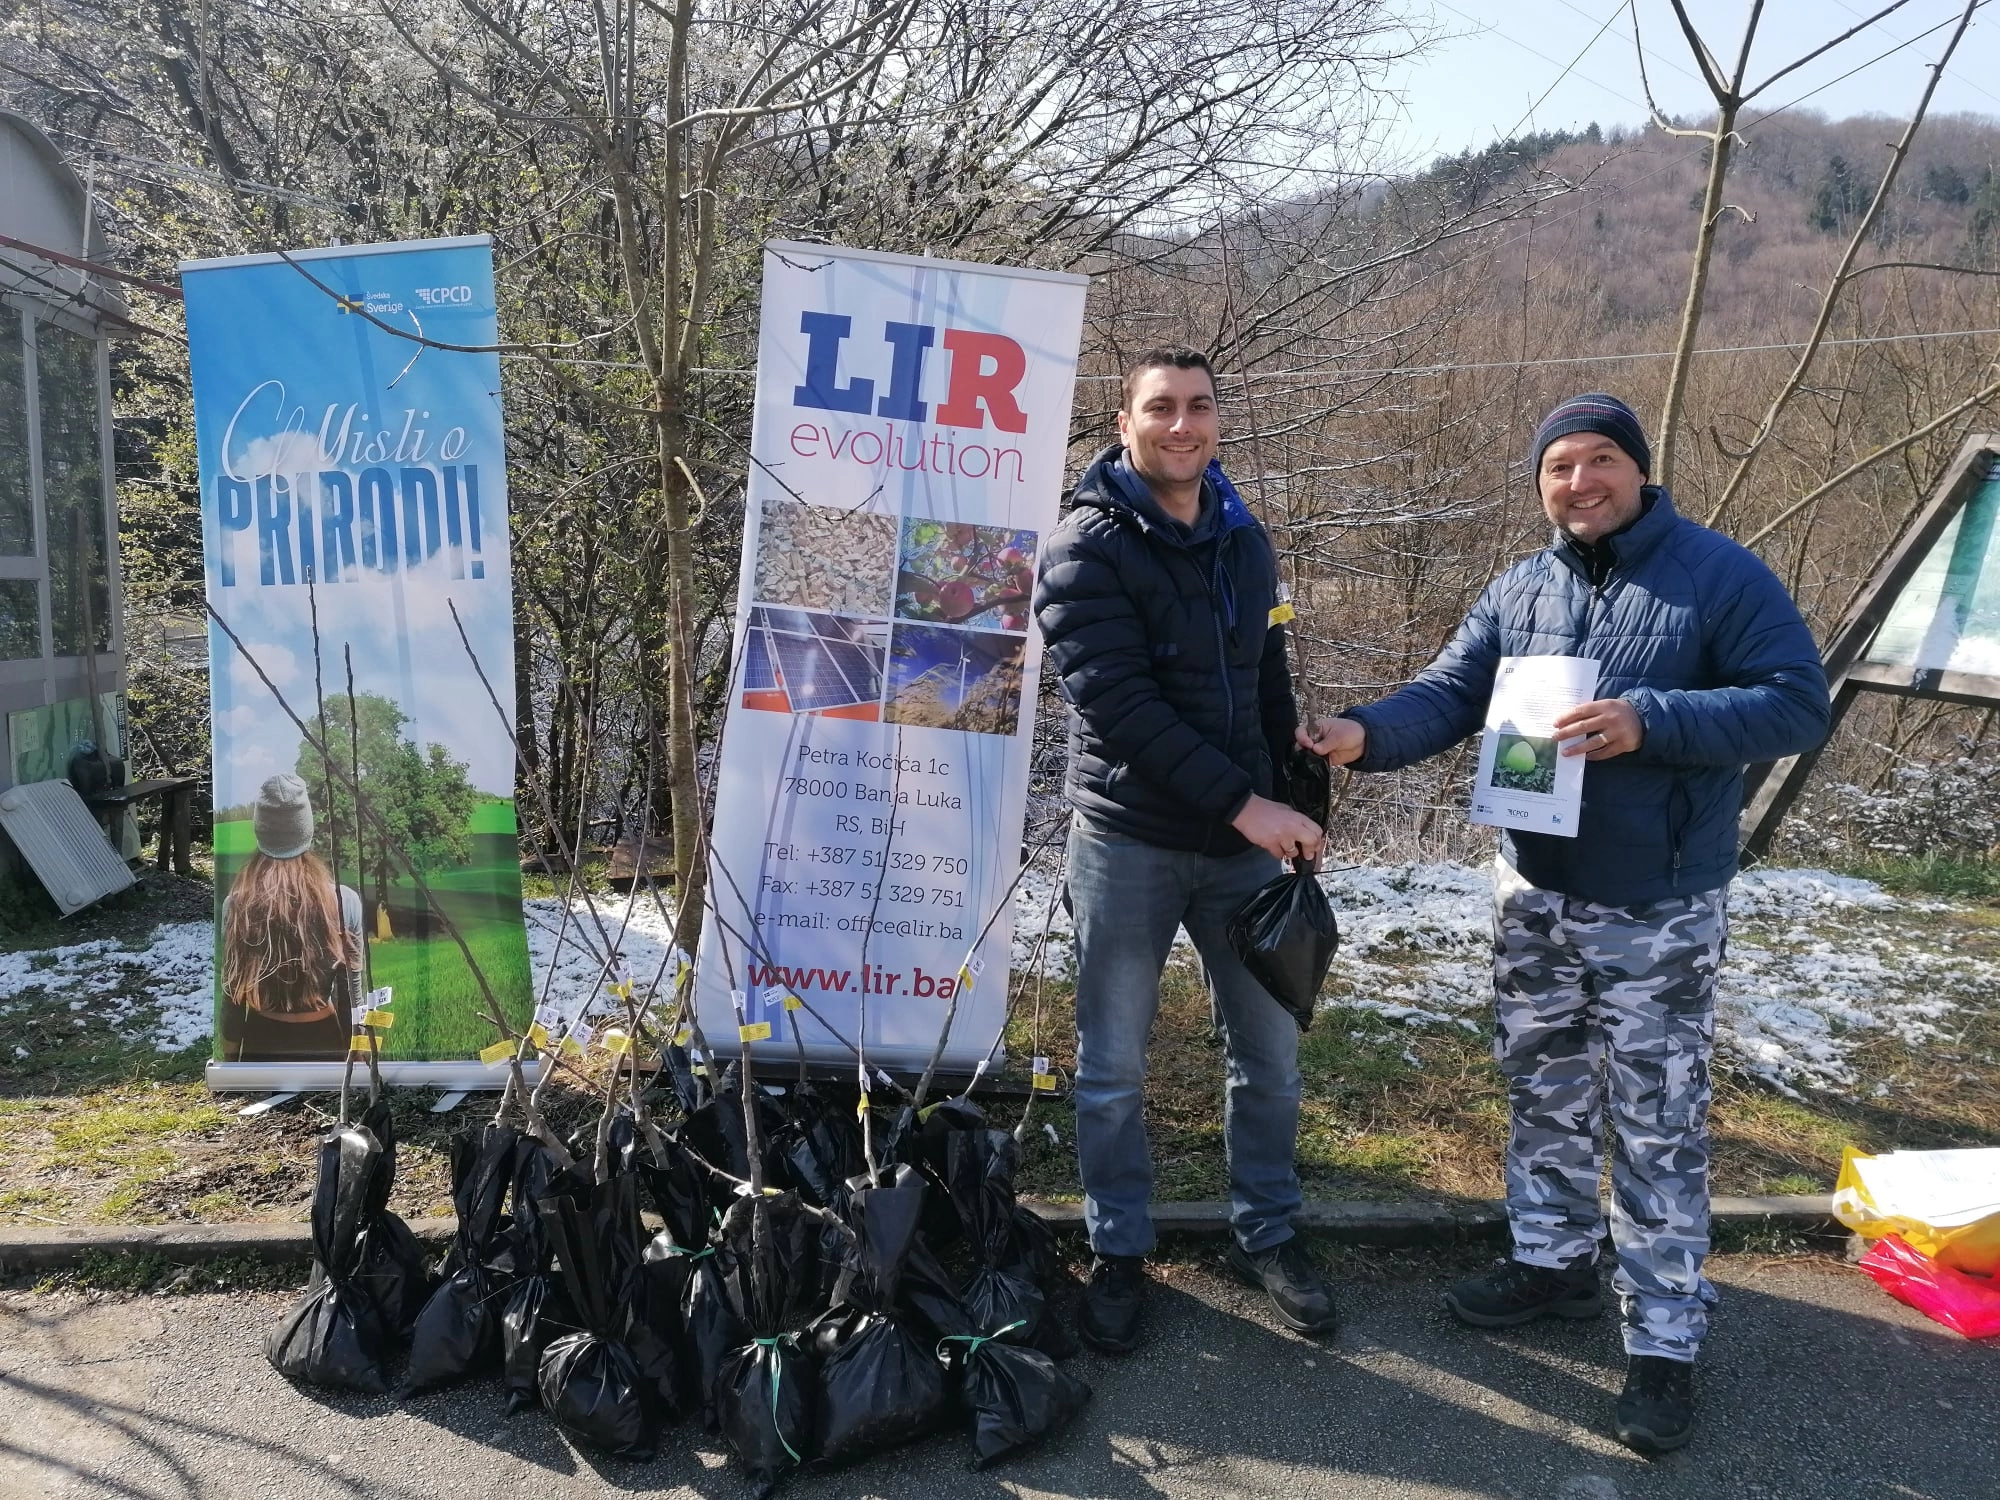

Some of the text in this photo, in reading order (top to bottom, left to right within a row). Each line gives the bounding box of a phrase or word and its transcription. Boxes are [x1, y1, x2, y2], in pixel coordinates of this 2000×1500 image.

[367, 302, 403, 313] Sverige
[431, 285, 472, 303] CPCD
[793, 311, 1028, 434] LIR
[221, 379, 474, 494] Misli o
[790, 423, 1024, 482] evolution
[217, 464, 485, 587] PRIRODI!
[799, 745, 950, 776] Petra Kočića 1c
[784, 777, 962, 810] 78000 Banja Luka
[836, 814, 863, 835] RS,
[765, 842, 968, 875] Tel: +387 51 329 750
[761, 875, 964, 908] Fax: +387 51 329 751
[754, 912, 963, 941] e-mail: office@lir.ba
[748, 963, 956, 1000] www.lir.ba
